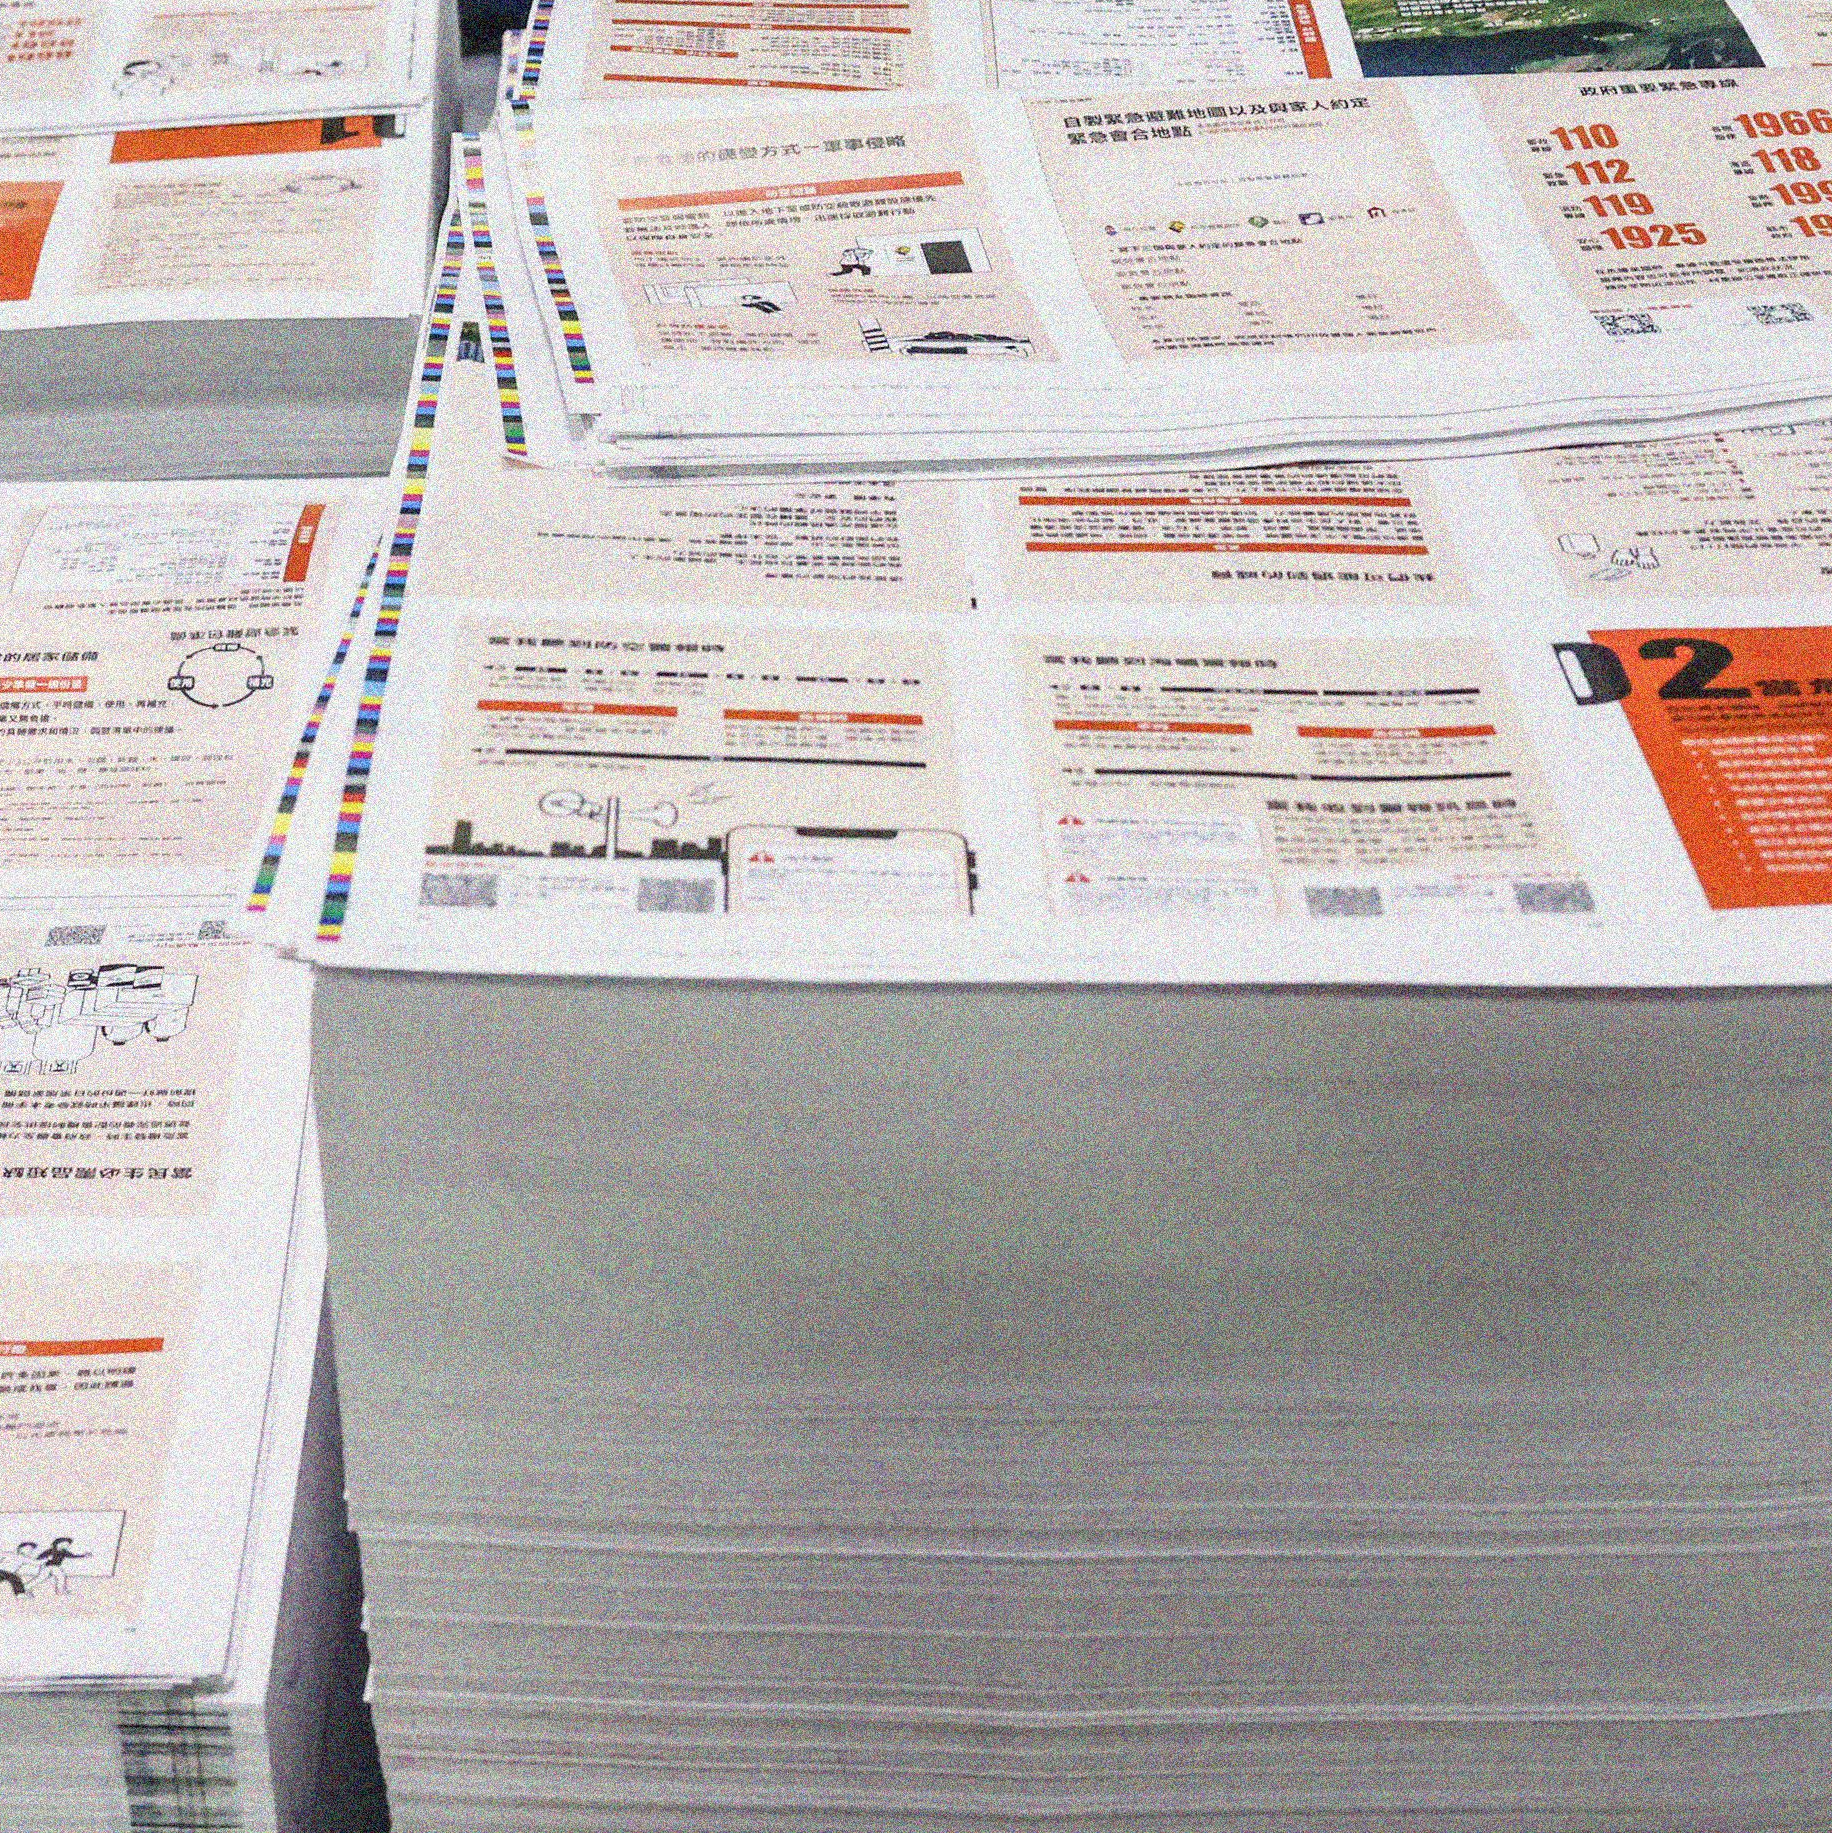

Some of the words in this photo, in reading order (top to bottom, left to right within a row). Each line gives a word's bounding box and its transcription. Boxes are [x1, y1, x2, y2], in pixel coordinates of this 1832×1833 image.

[1552, 124, 1619, 150] 110
[1570, 159, 1631, 185] 112
[1757, 147, 1820, 172] 118
[1587, 193, 1654, 216] 119
[1606, 224, 1707, 249] 1925
[1552, 638, 1753, 706] 02
